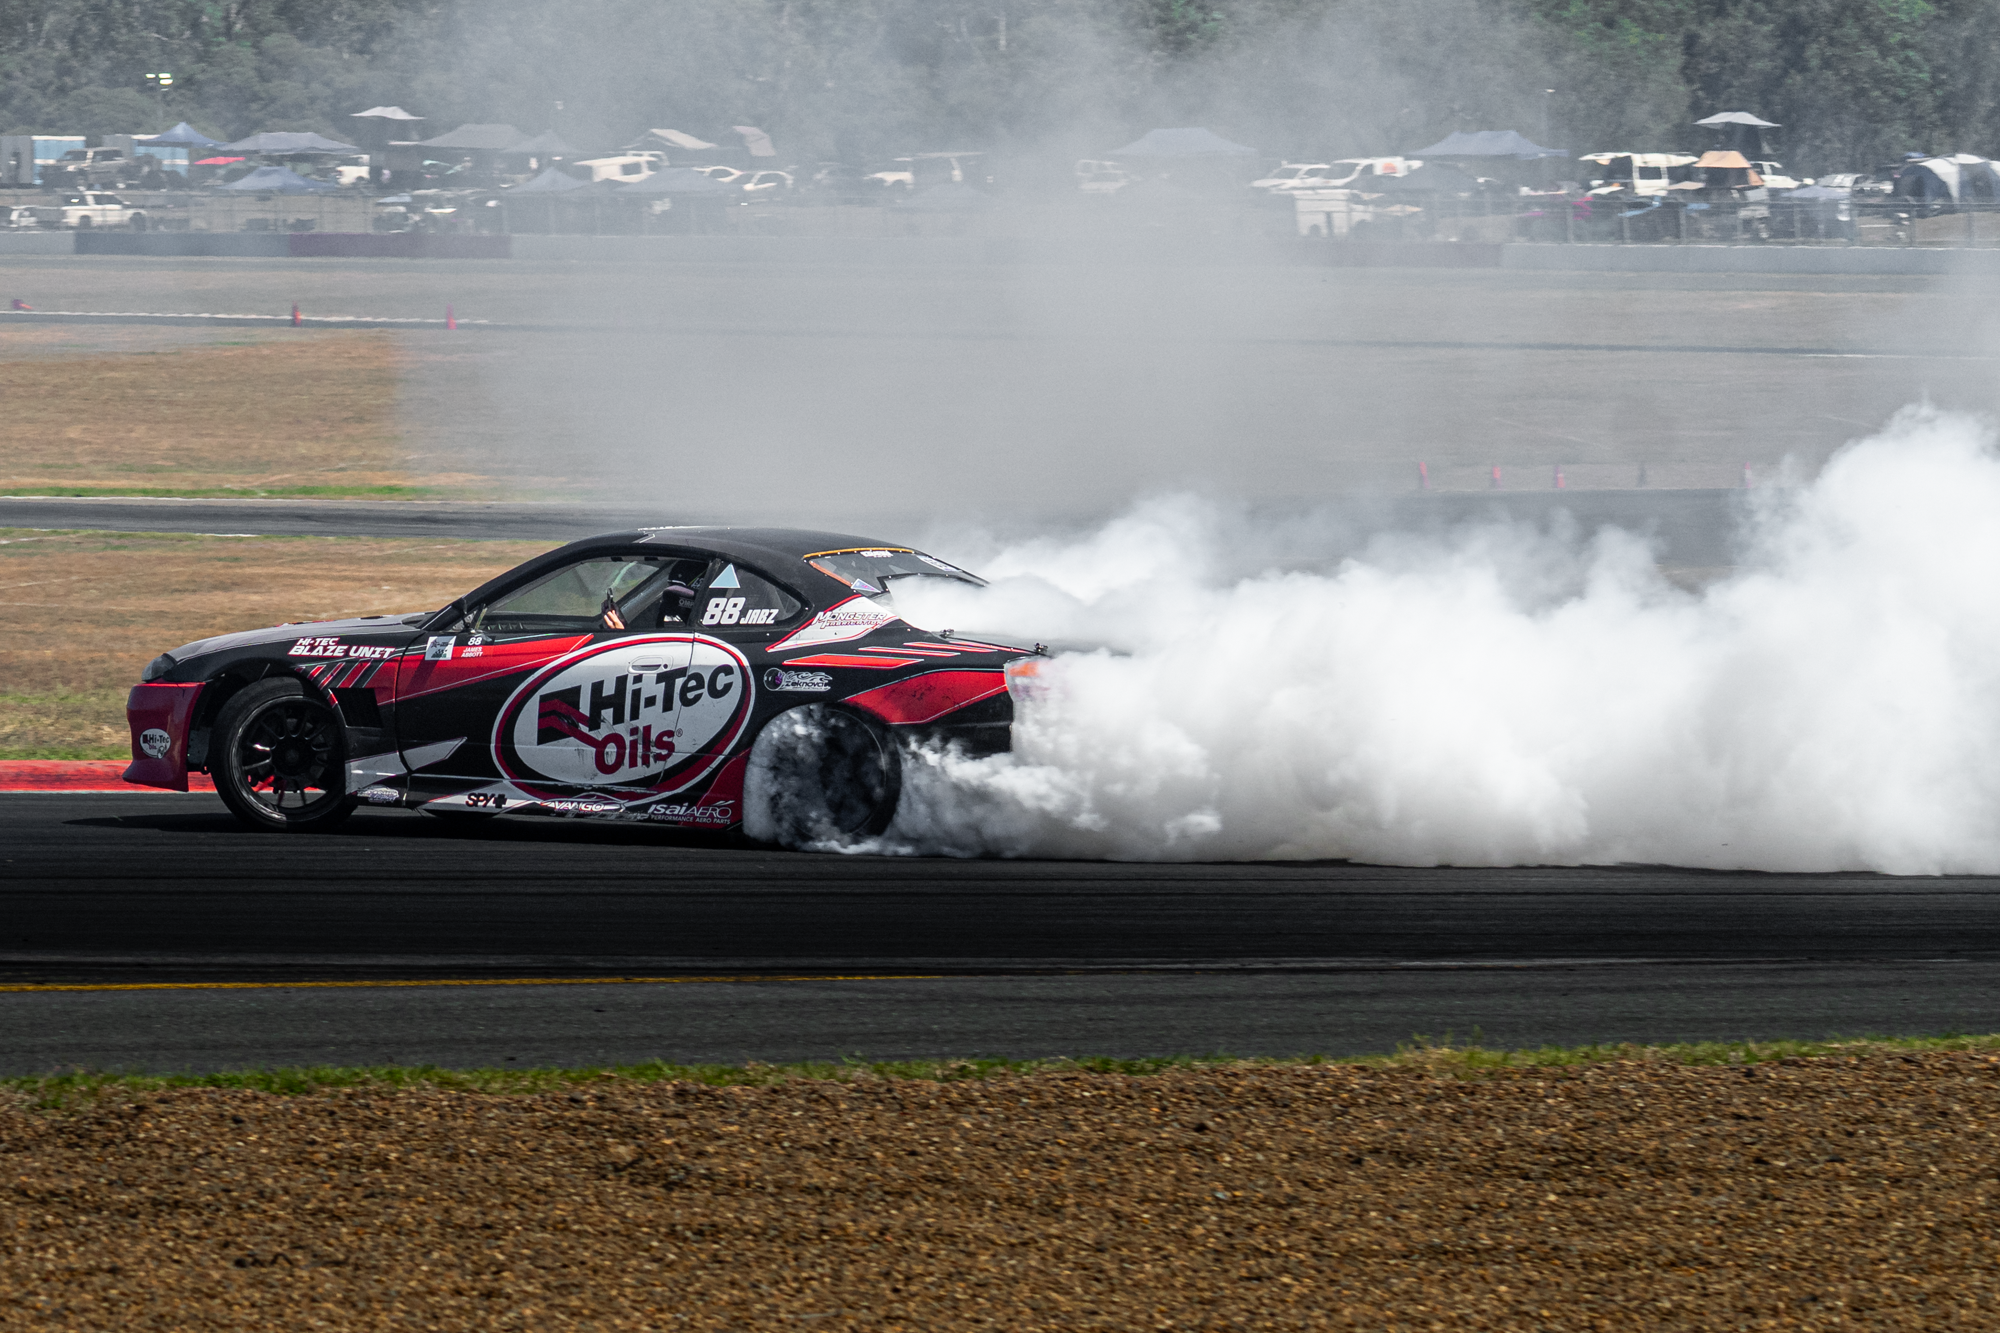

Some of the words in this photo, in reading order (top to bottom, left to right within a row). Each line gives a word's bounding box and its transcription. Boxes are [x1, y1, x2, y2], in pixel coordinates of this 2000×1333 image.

[702, 597, 747, 625] 88
[740, 608, 779, 624] JABZ
[296, 637, 339, 646] HI-TEC
[468, 637, 483, 645] 88
[288, 646, 348, 656] BLAZE
[349, 646, 396, 658] UNIT
[588, 664, 735, 732] Hi-Tec
[651, 814, 693, 822] PERFORMANCE
